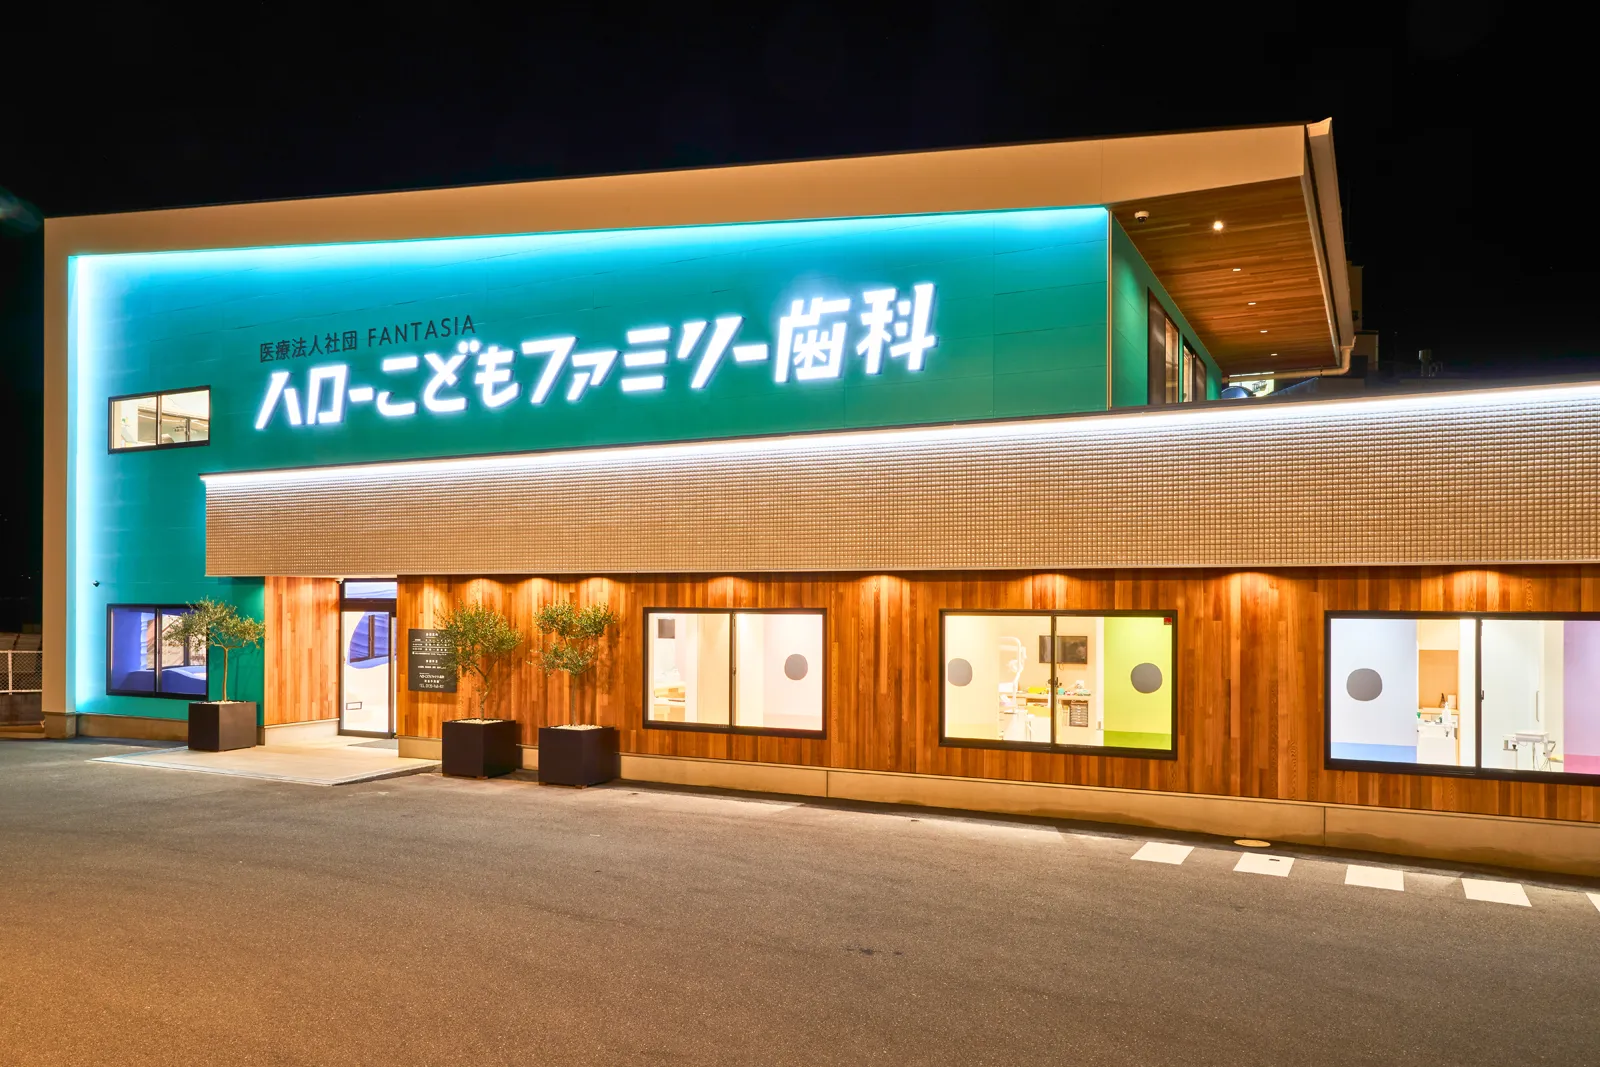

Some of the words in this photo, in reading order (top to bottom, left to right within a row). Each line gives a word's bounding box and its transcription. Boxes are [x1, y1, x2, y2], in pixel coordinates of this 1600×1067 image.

[254, 282, 939, 431] ハローこどもファミリー歯科
[259, 330, 358, 363] 医療法人社団
[367, 315, 476, 347] FANTASIA
